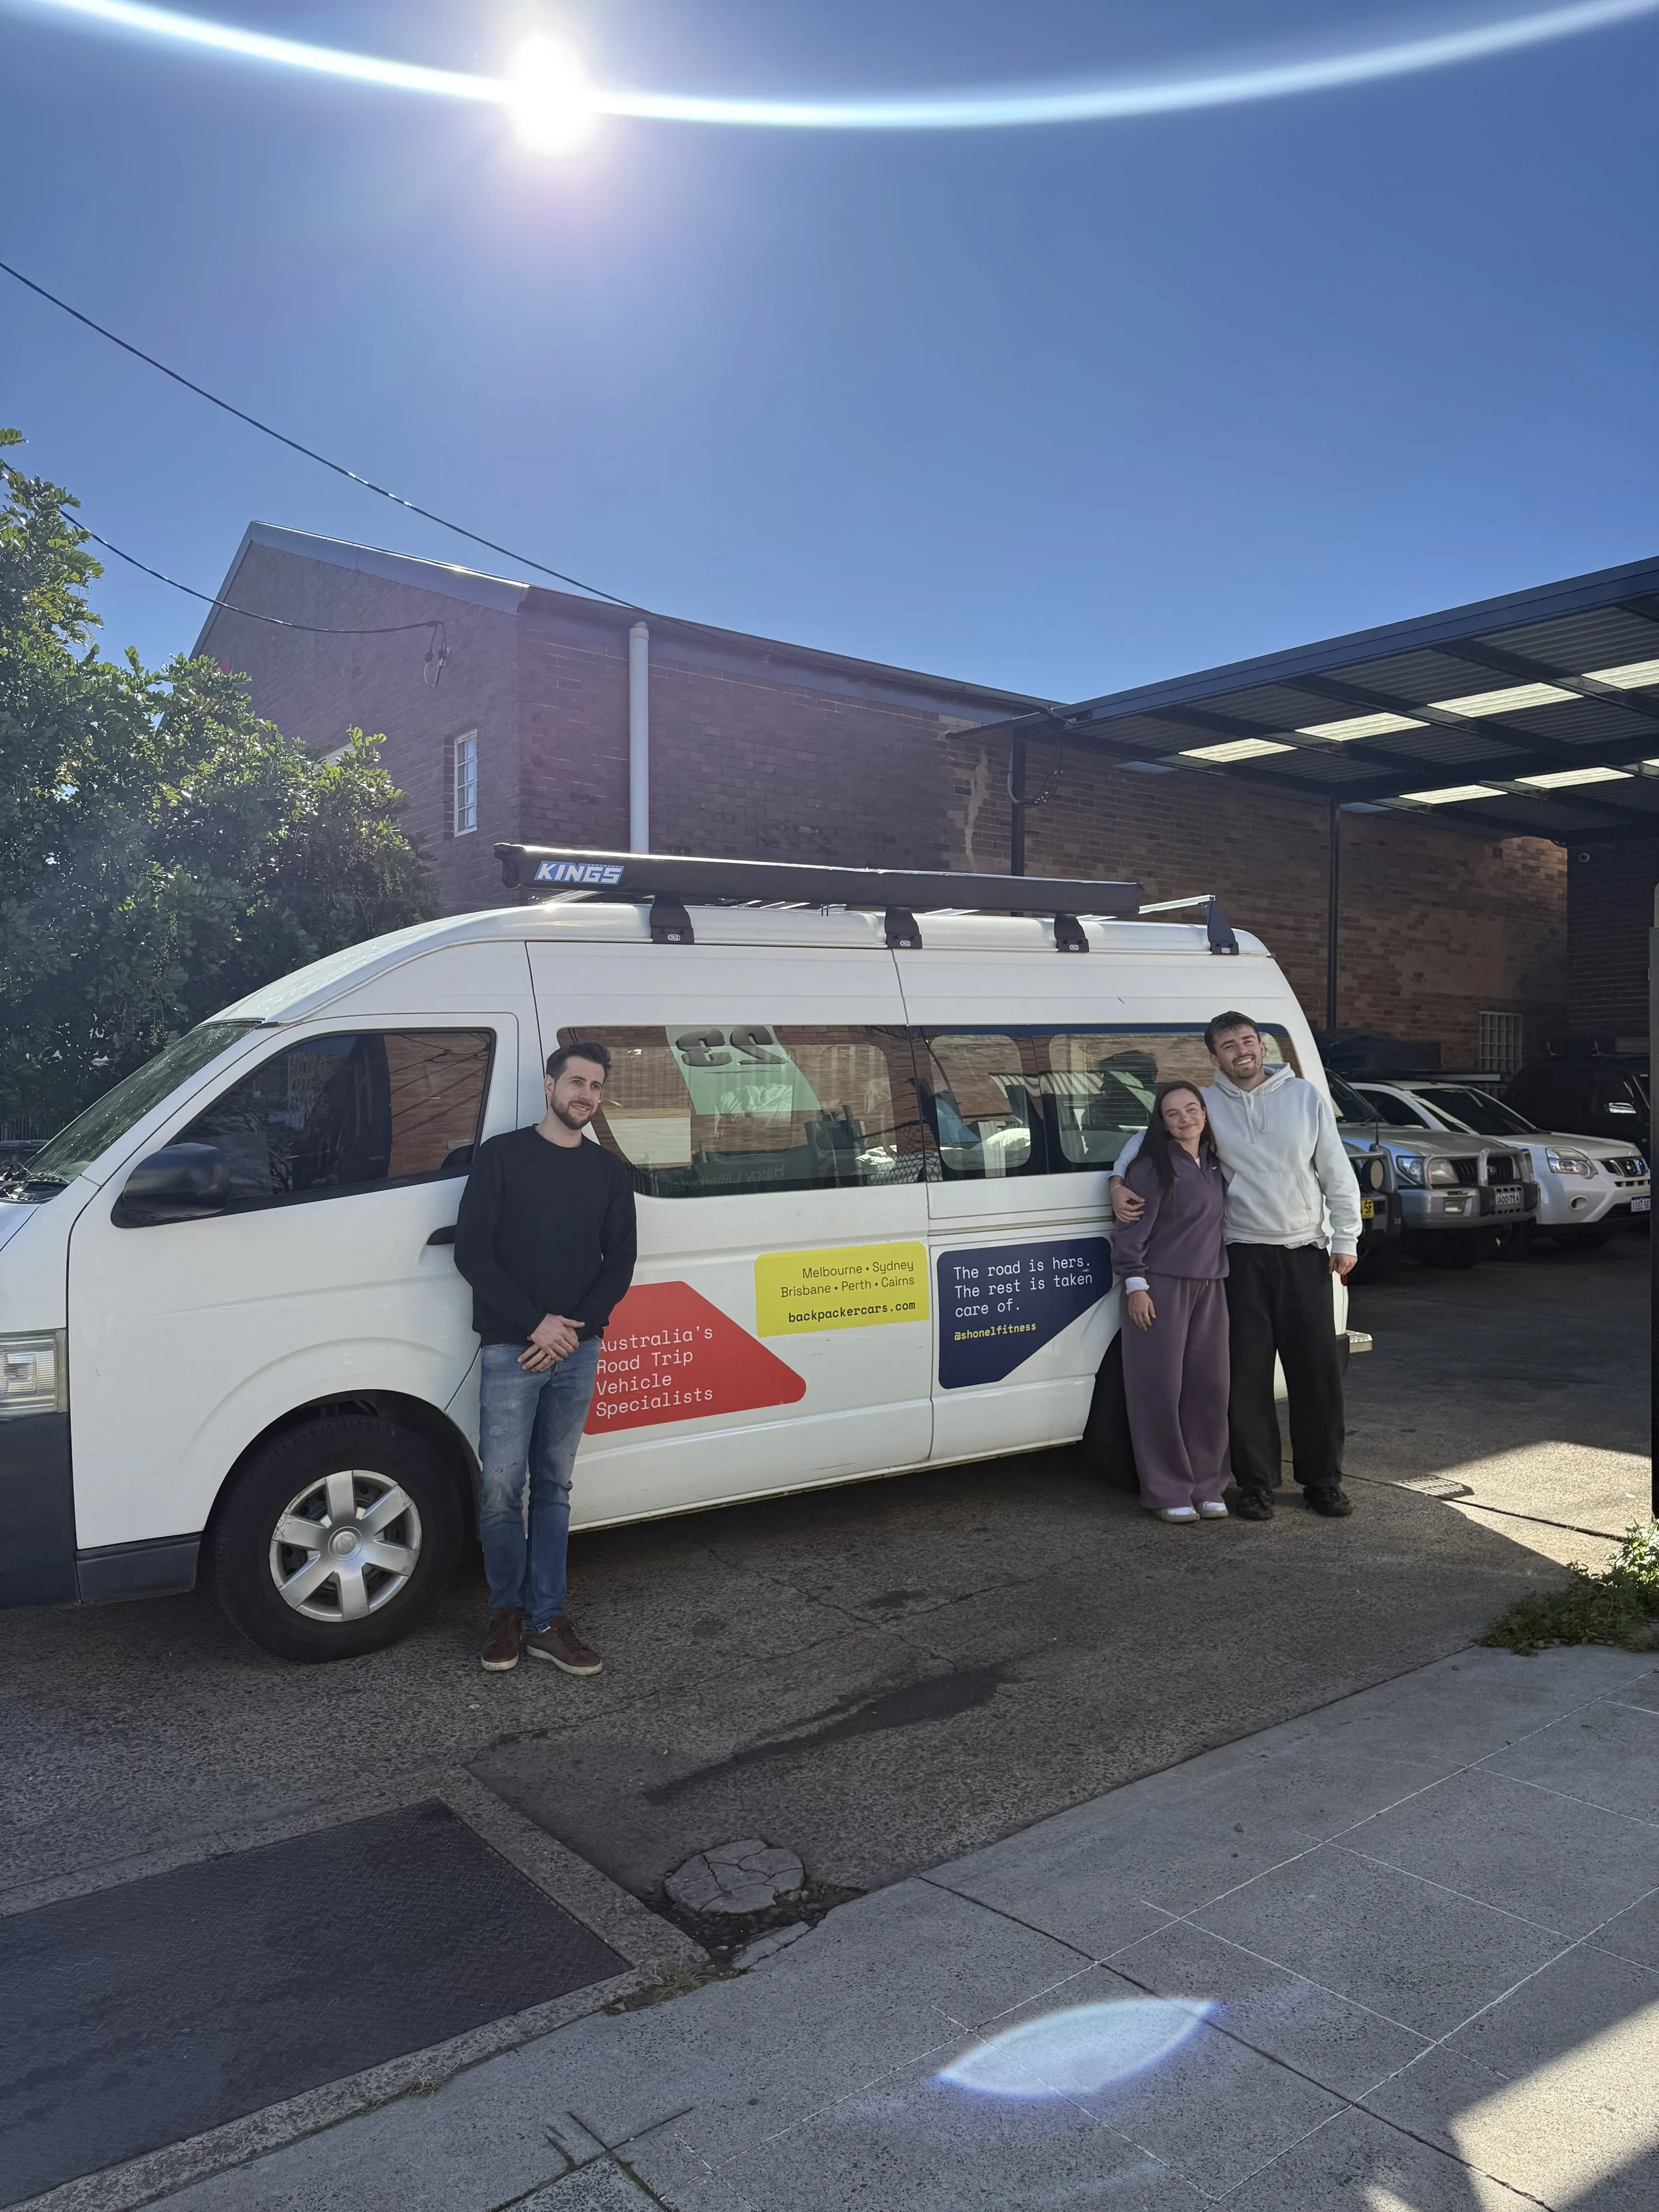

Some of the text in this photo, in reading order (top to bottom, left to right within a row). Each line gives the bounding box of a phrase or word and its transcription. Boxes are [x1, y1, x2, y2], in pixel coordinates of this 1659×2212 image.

[538, 863, 622, 883] KINGS
[802, 1261, 914, 1279] Melbourne Sydney
[954, 1256, 1090, 1280] The road is hers.
[780, 1277, 915, 1297] Brisbane Perth Cairns
[955, 1273, 1093, 1298] The rest is taken
[788, 1301, 916, 1323] backpackercars.com
[955, 1298, 1020, 1317] care of.
[600, 1325, 713, 1353] Australia's
[954, 1323, 1037, 1341] @shonelfitness
[597, 1349, 693, 1374] Road Trip
[596, 1373, 672, 1396] Vehicle
[596, 1388, 713, 1419] Specialists
